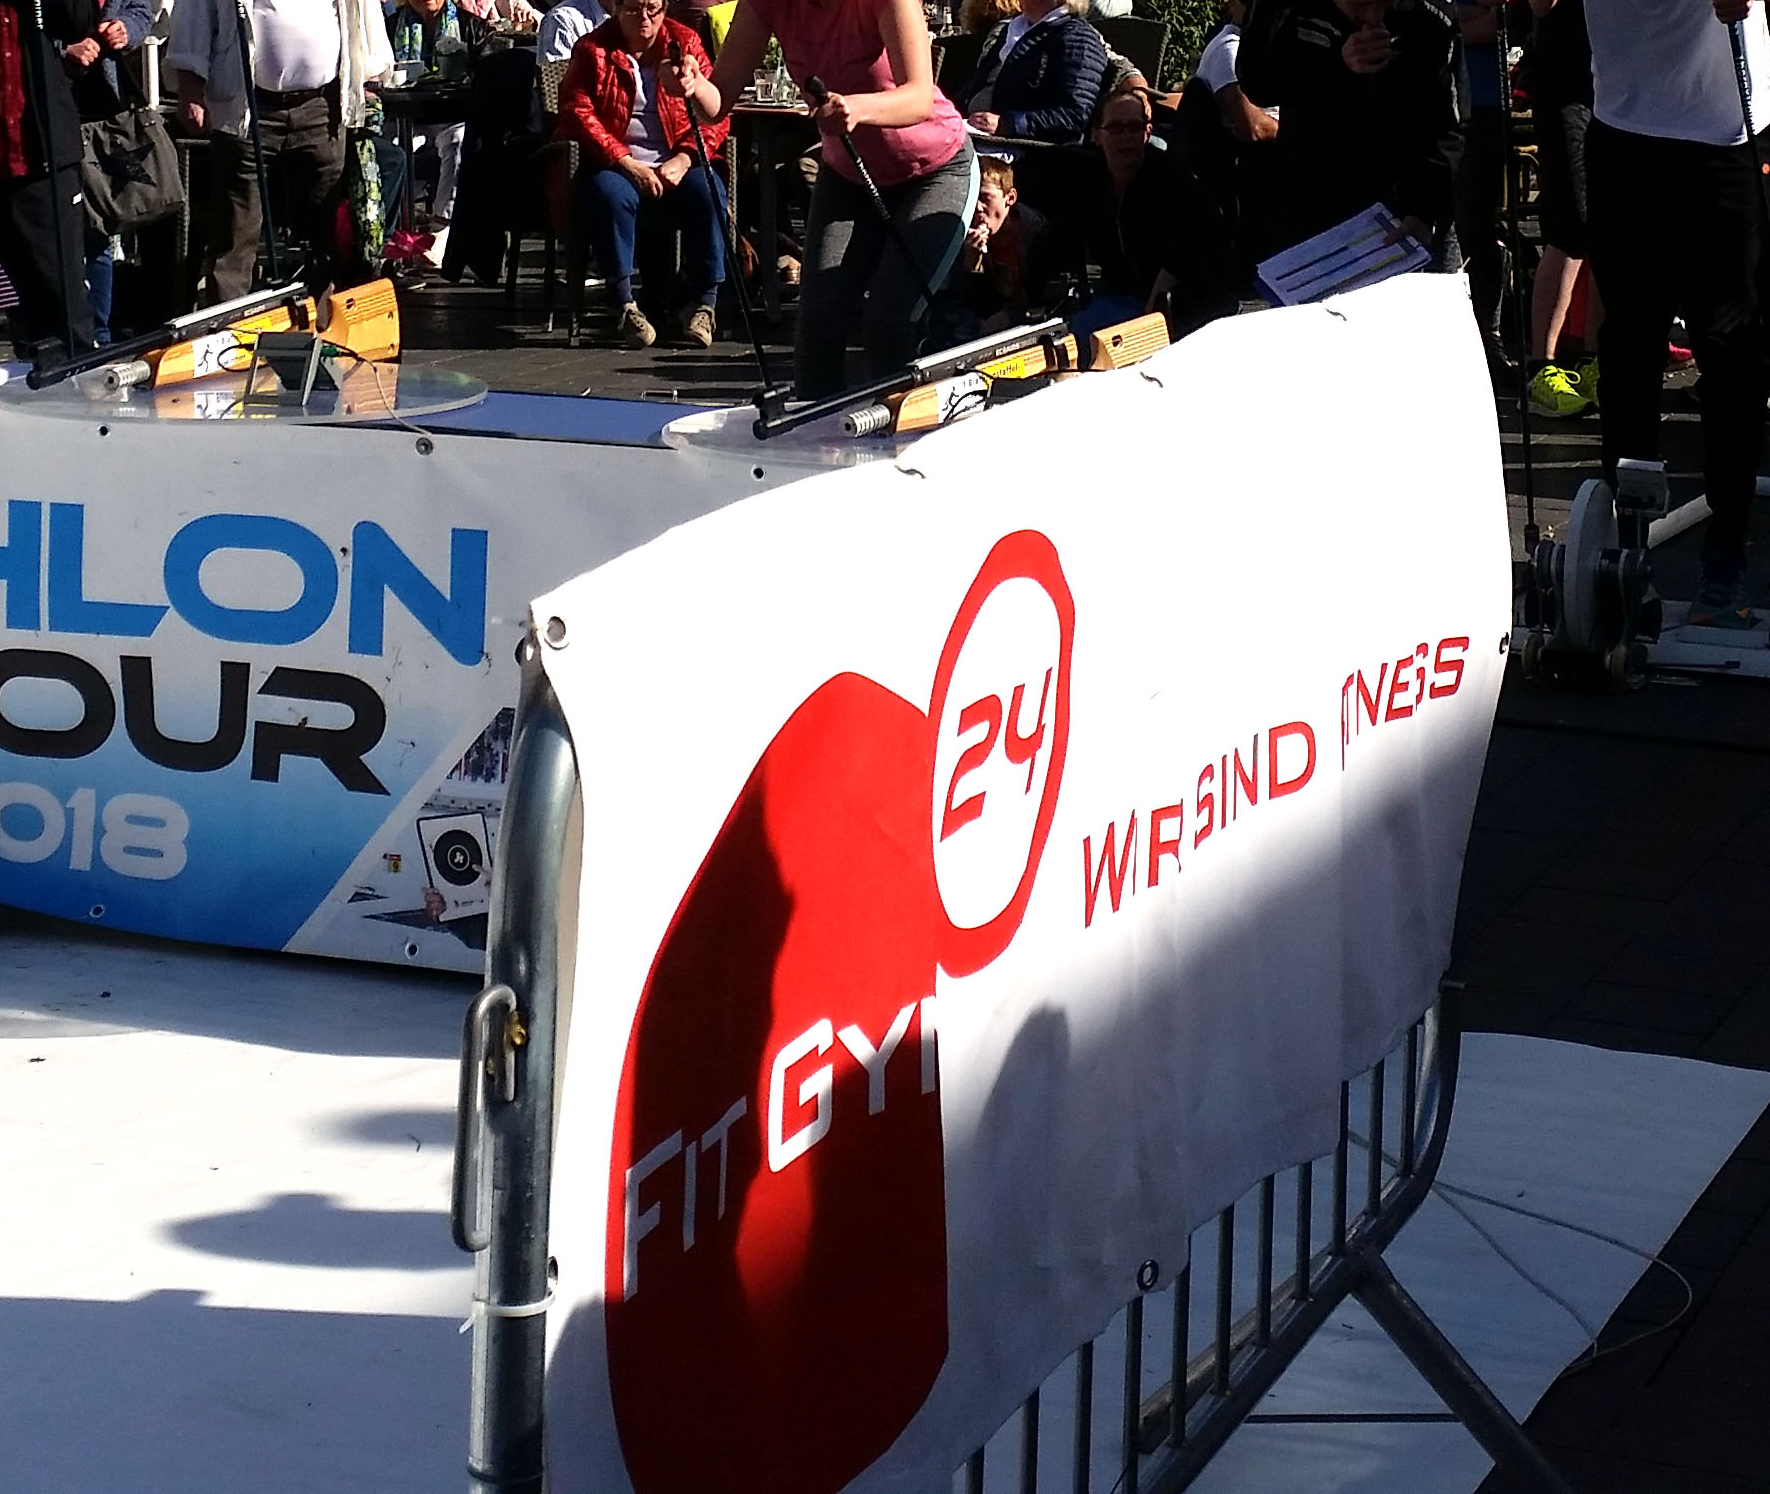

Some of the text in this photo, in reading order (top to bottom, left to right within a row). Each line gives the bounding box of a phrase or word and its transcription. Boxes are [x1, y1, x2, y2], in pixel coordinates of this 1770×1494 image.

[938, 666, 1054, 844] 24
[1082, 798, 1183, 930] WR
[1194, 720, 1317, 851] SIND
[622, 1092, 748, 1304] FIT
